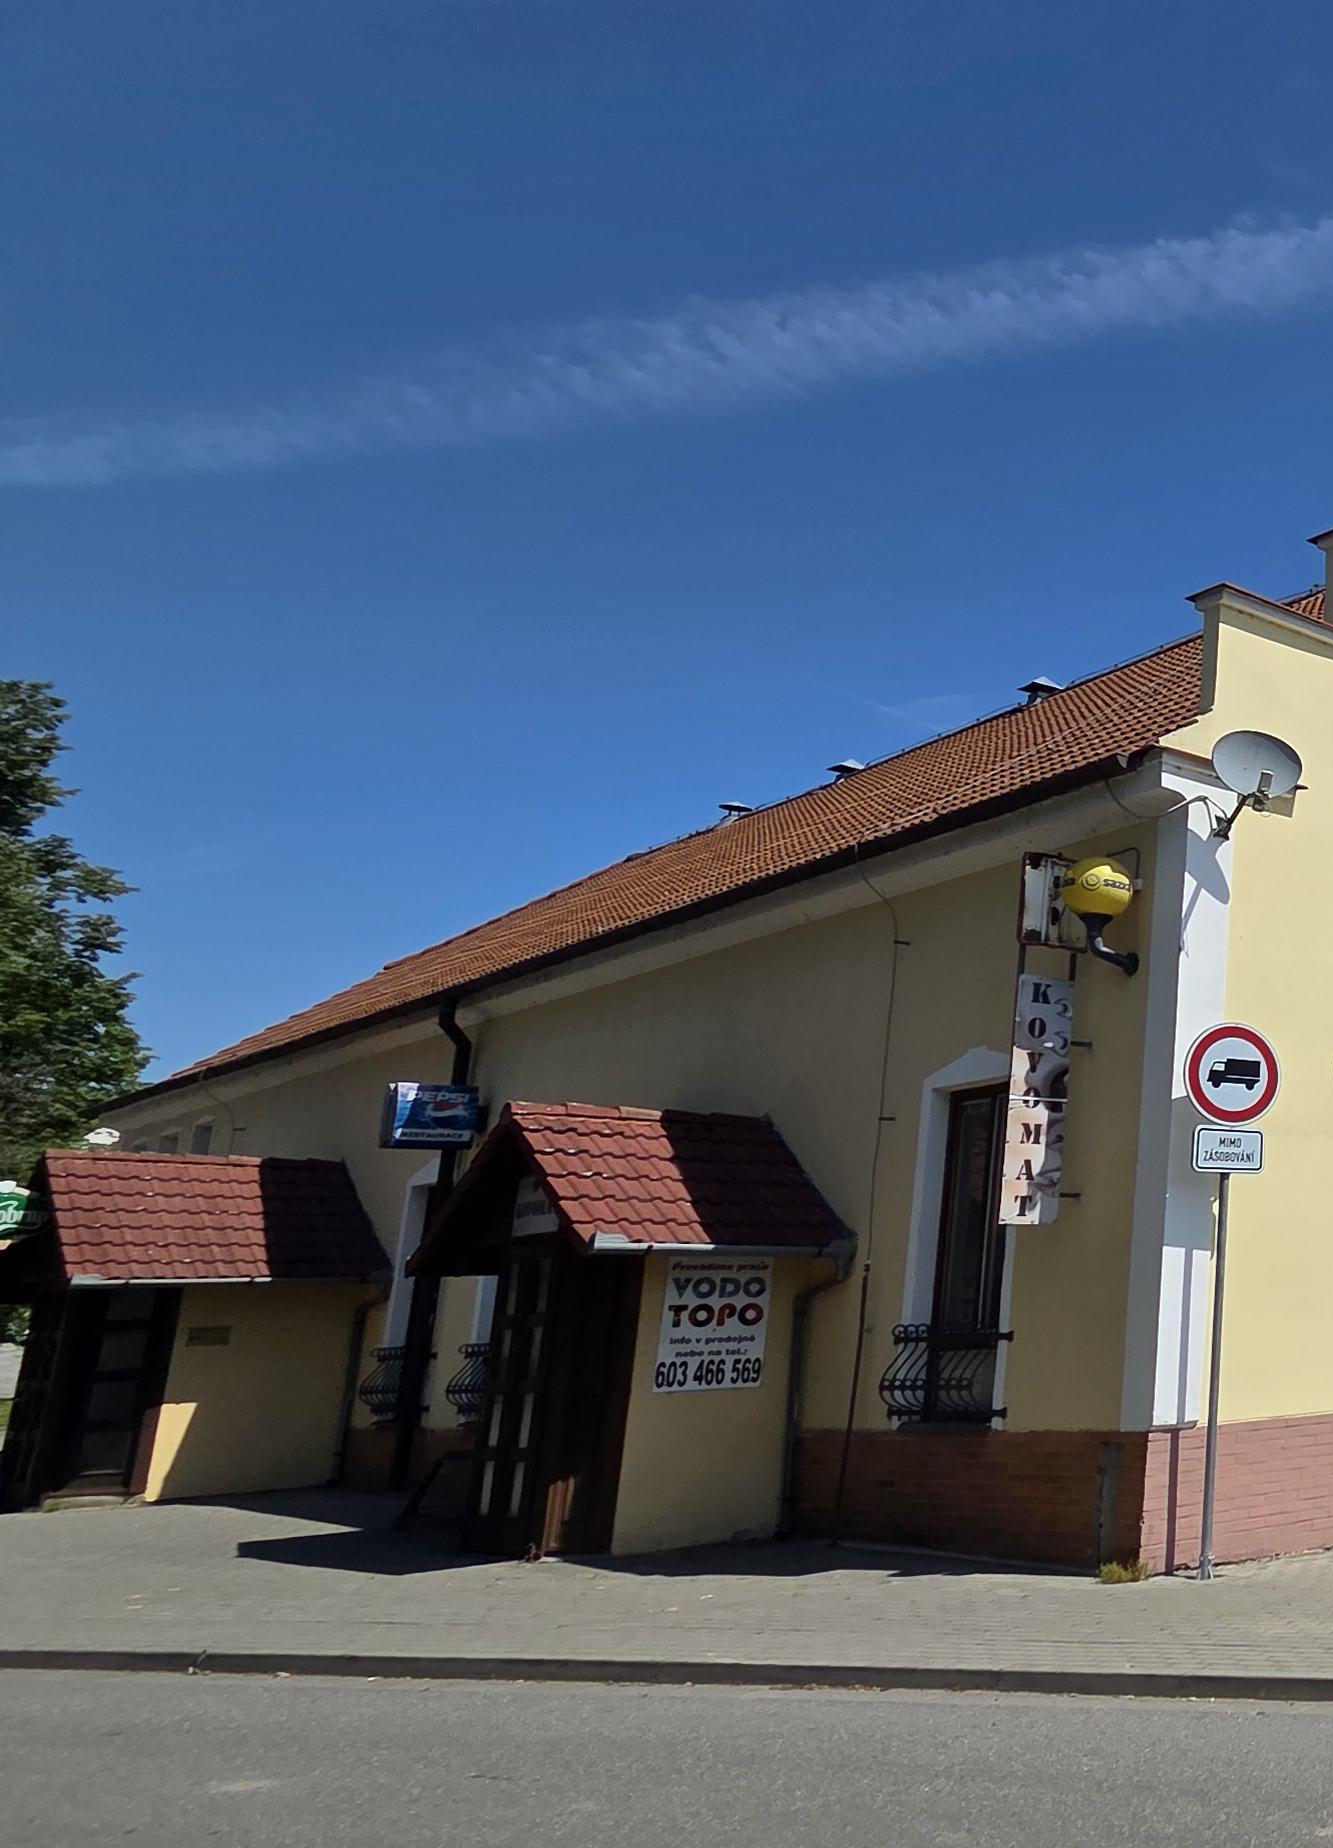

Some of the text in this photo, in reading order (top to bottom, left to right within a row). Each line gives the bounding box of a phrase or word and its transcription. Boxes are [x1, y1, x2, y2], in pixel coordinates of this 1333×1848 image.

[1013, 981, 1053, 1218] KOVOMAT
[1219, 1136, 1242, 1148] MIMO
[1203, 1148, 1255, 1163] ZÁSOBOVÁNÍ
[672, 1276, 767, 1299] VODO
[668, 1302, 764, 1328] TOPO
[675, 1349, 705, 1358] nebo
[655, 1356, 762, 1389] 603 466 569
